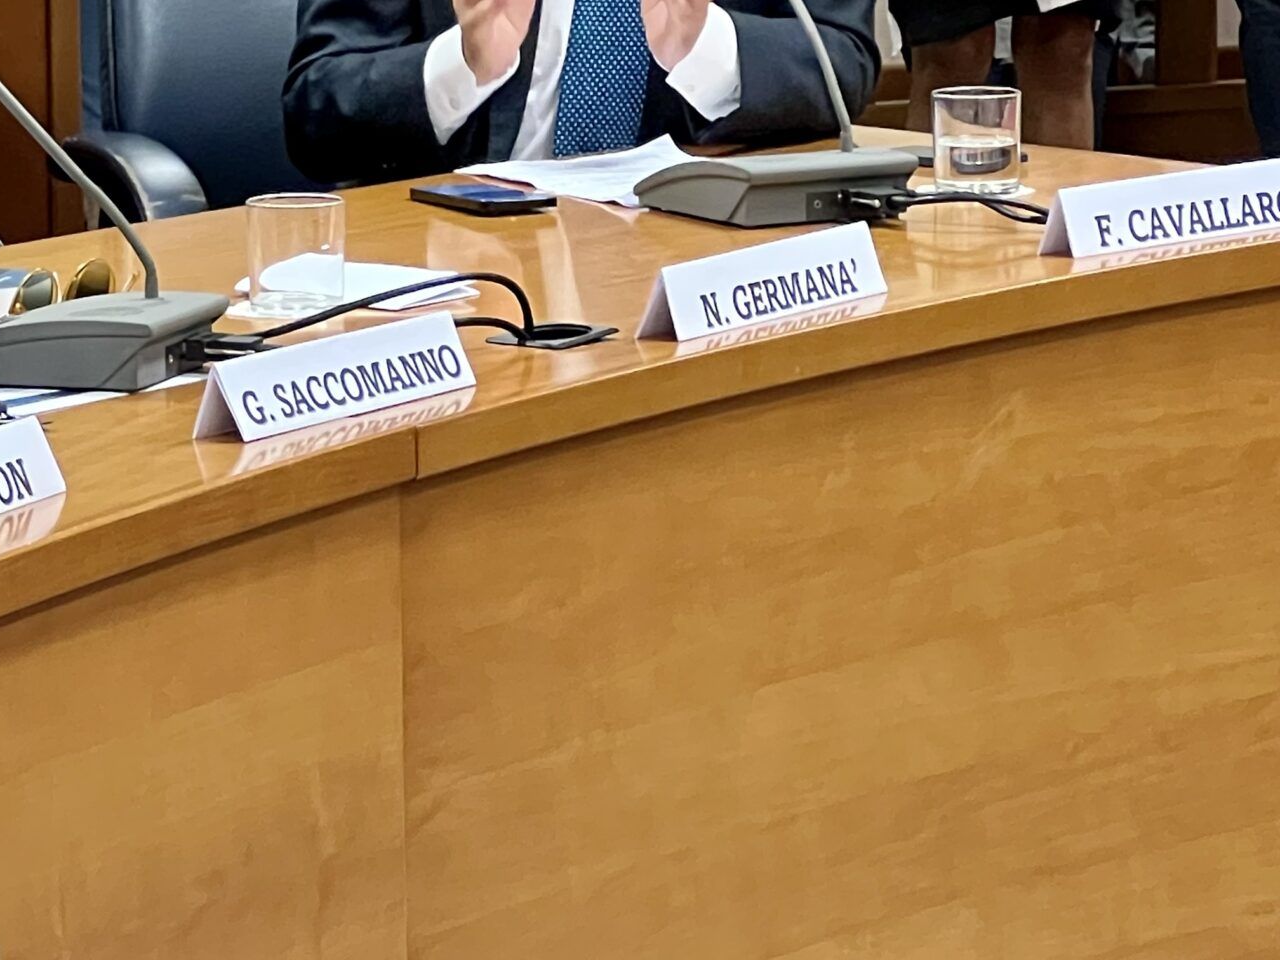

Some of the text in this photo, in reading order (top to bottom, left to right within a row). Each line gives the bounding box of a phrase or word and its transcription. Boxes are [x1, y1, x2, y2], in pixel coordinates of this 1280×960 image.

[1094, 214, 1124, 247] F.
[700, 291, 731, 329] N.
[732, 257, 859, 321] GERMANA'
[242, 344, 462, 426] G. SACCOMANNO
